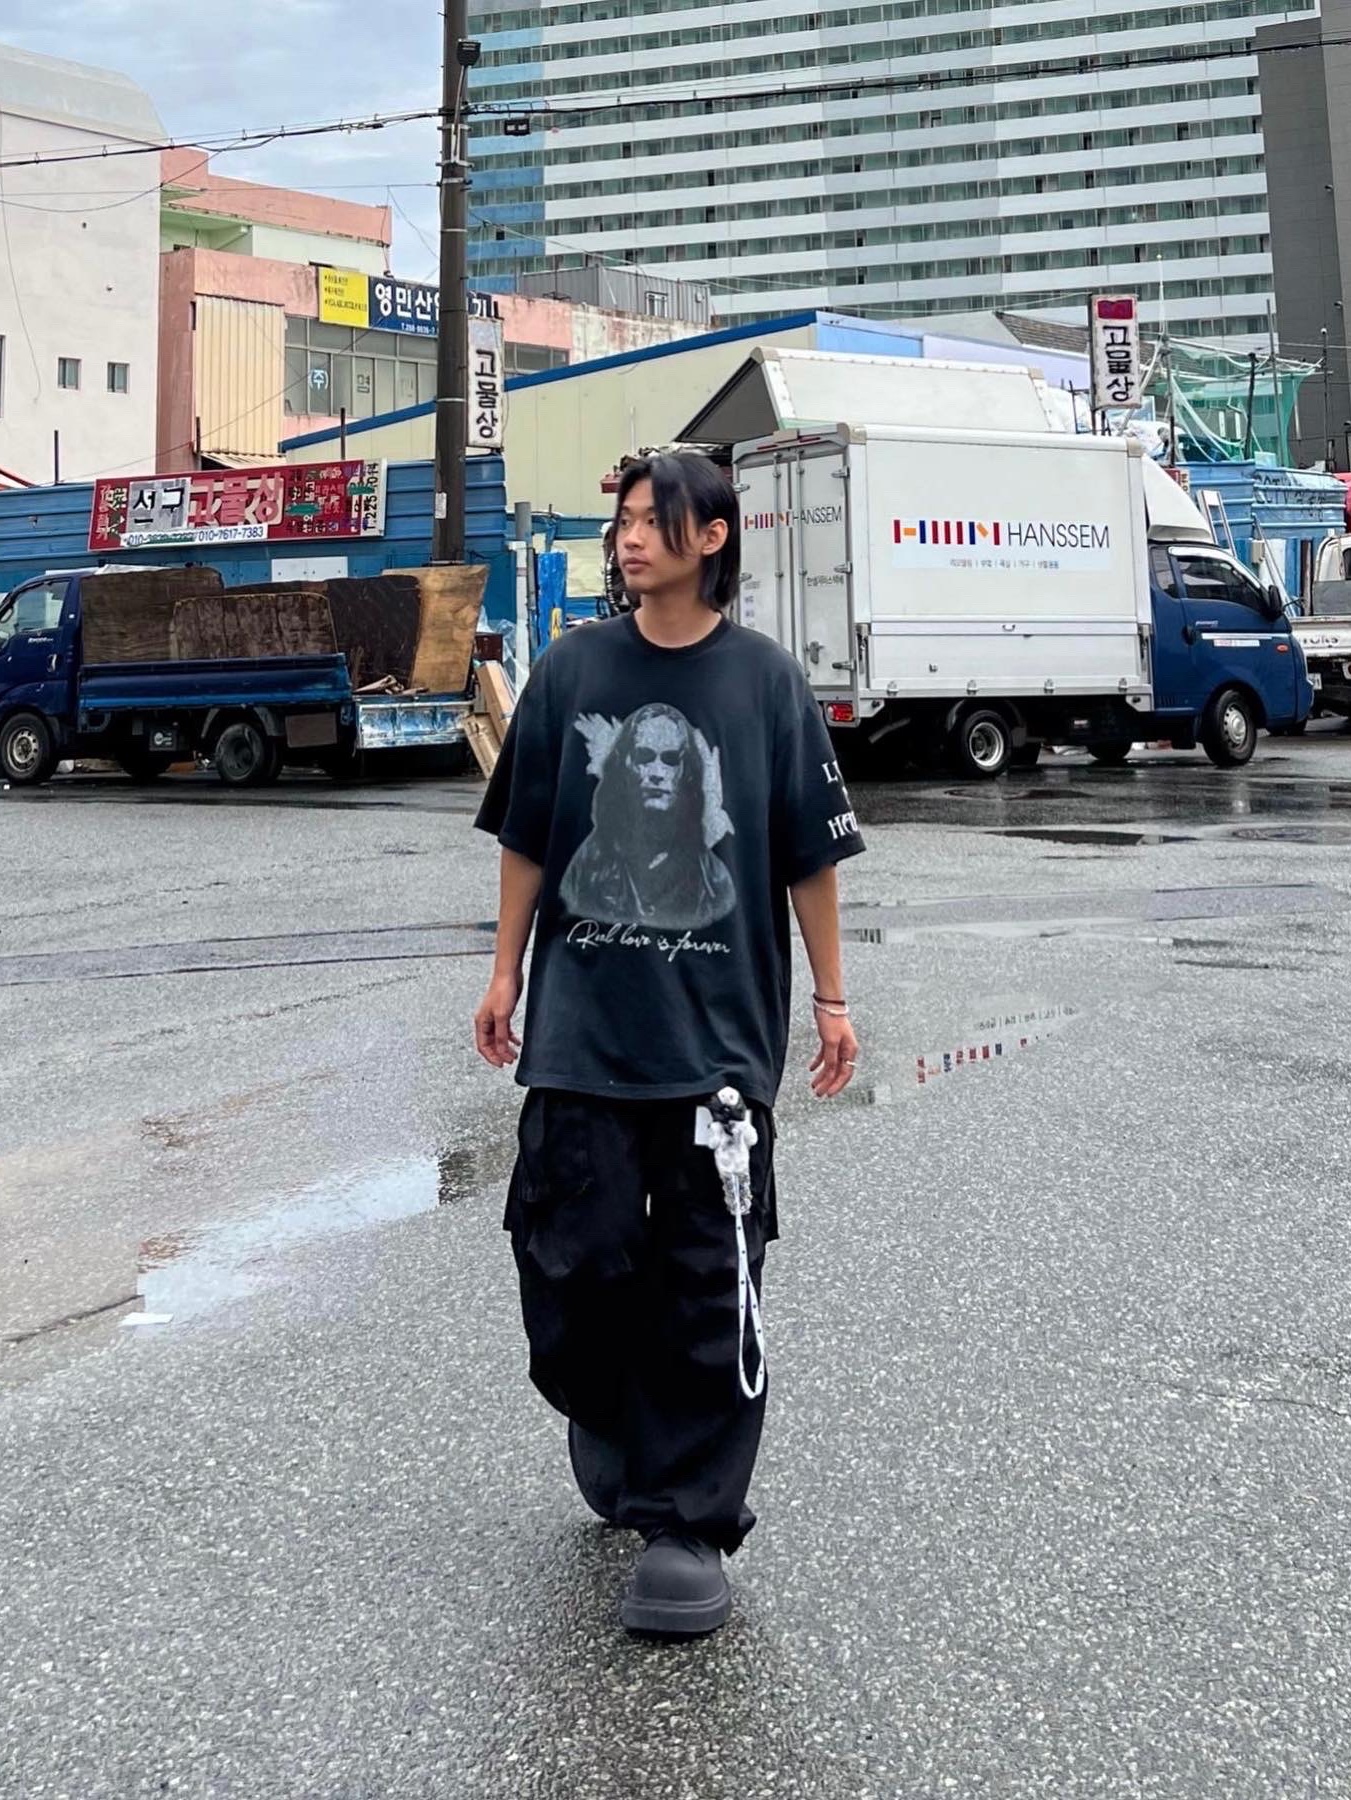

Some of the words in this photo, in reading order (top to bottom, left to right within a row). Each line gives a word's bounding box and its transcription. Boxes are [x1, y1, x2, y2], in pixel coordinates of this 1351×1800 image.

[1102, 325, 1134, 402] 고물상
[475, 349, 498, 438] 고물상
[1007, 522, 1110, 549] HANSSEM
[619, 922, 652, 948] love
[668, 930, 731, 963] forever
